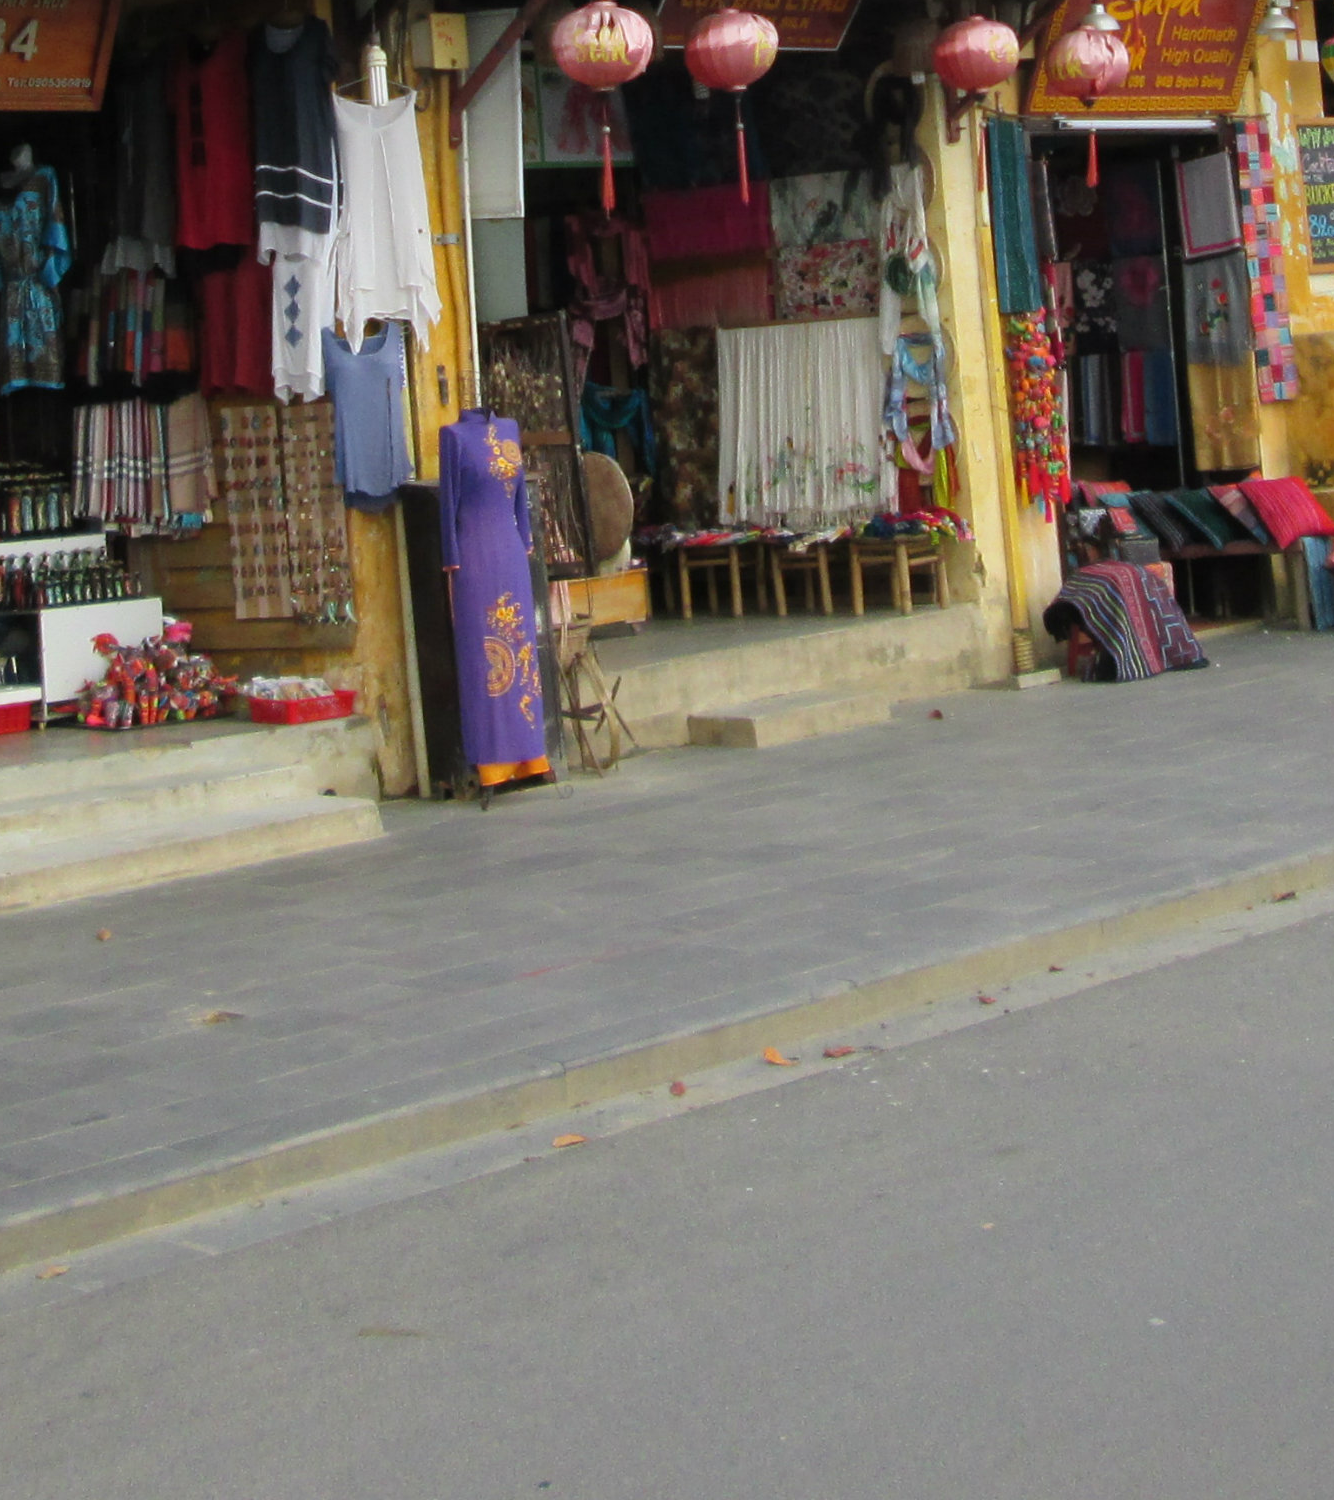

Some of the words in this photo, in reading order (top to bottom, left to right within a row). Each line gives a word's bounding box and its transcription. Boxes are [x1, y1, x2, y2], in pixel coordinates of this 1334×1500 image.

[1171, 25, 1238, 42] Handmade
[1160, 47, 1190, 67] High
[1192, 47, 1235, 67] Quality
